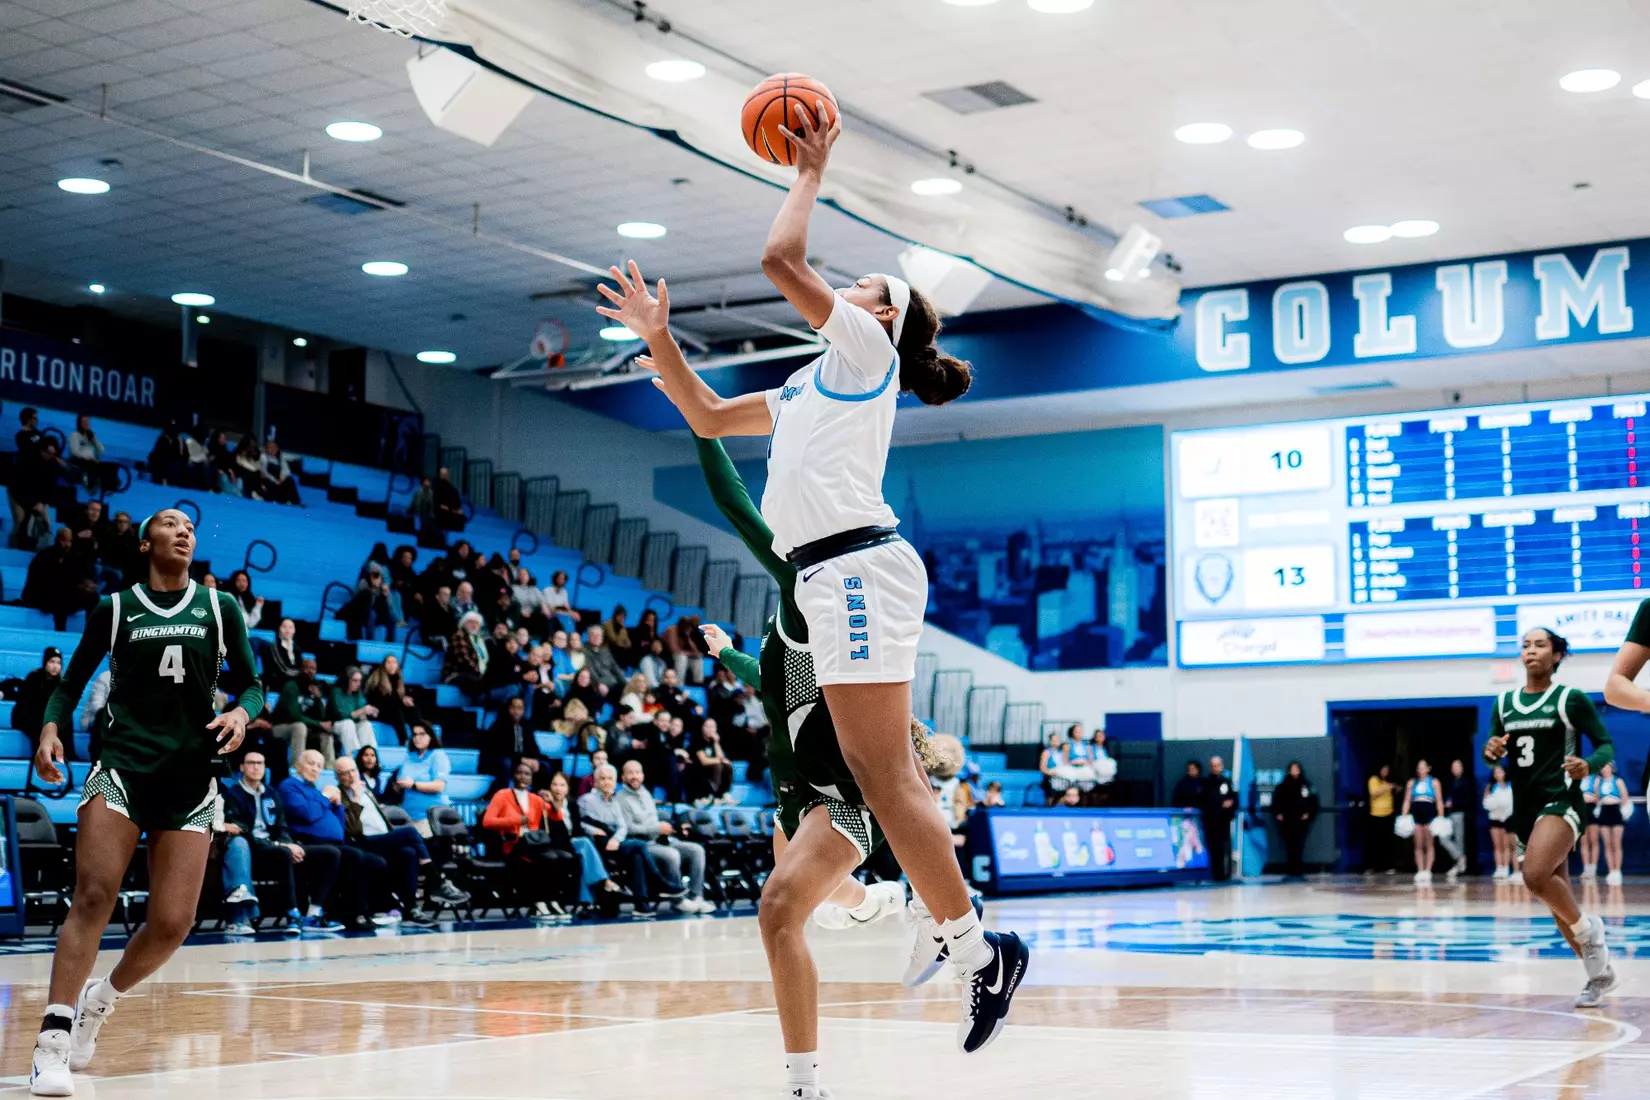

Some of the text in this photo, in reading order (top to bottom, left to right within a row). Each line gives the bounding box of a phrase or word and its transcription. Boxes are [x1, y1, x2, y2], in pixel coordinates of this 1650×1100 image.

[1195, 246, 1634, 372] COLUM
[1270, 449, 1303, 470] 10
[1273, 566, 1307, 587] 13
[131, 625, 206, 640] BINGHAMTON
[843, 576, 869, 660] LIONS
[158, 644, 186, 684] 4
[1516, 735, 1535, 768] 3
[972, 855, 991, 882] C
